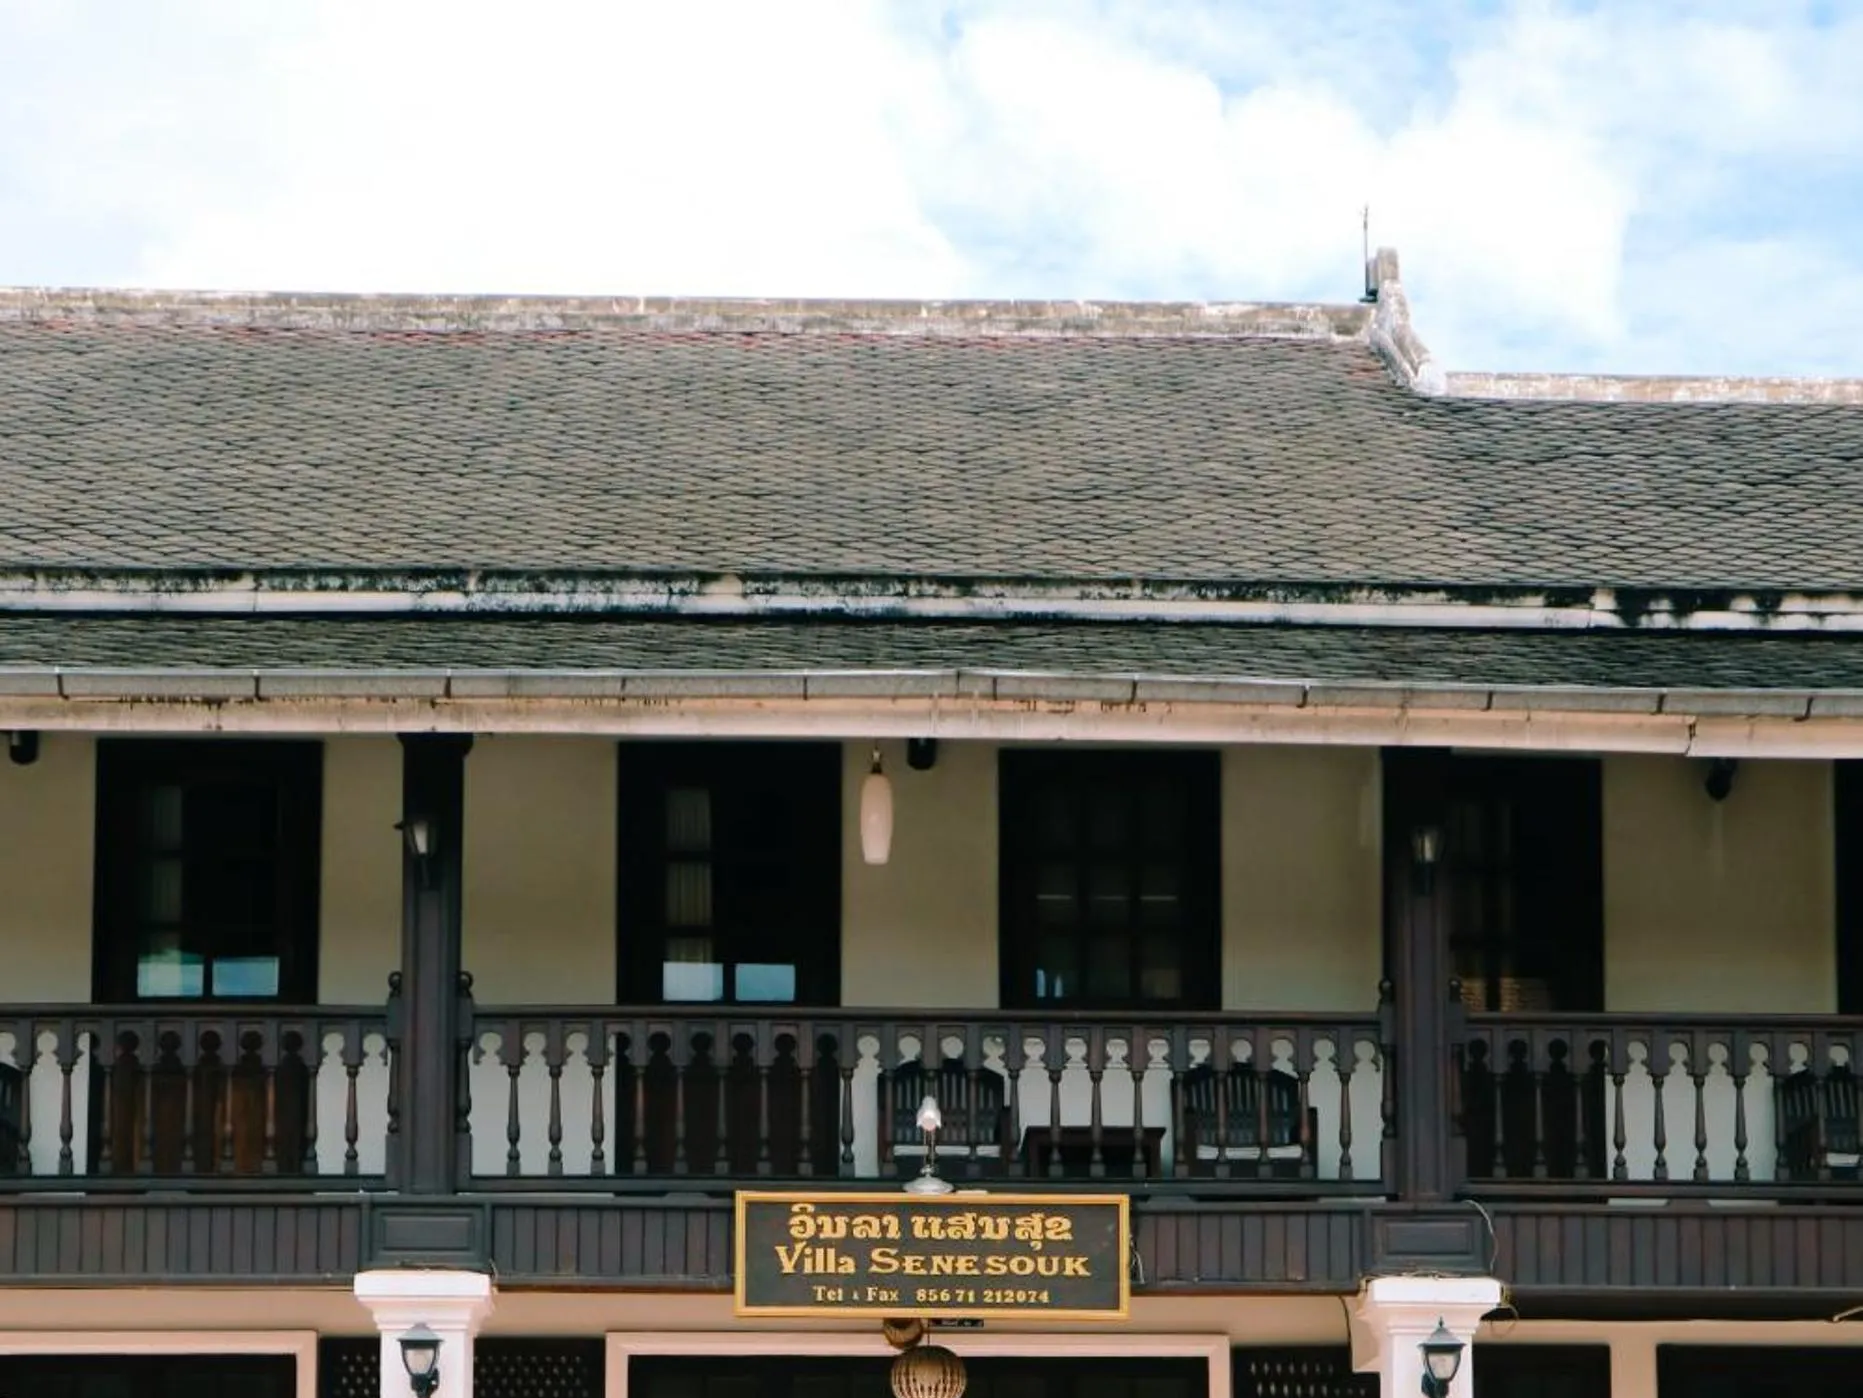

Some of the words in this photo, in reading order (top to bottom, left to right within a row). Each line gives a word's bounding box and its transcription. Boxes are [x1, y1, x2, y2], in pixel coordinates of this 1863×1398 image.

[774, 1241, 856, 1274] Villa
[868, 1247, 1092, 1277] SENESOUK
[813, 1285, 843, 1301] Tel
[866, 1286, 899, 1302] Fax
[916, 1288, 951, 1302] 856
[955, 1289, 975, 1303] 71
[983, 1289, 1049, 1304] 212074
